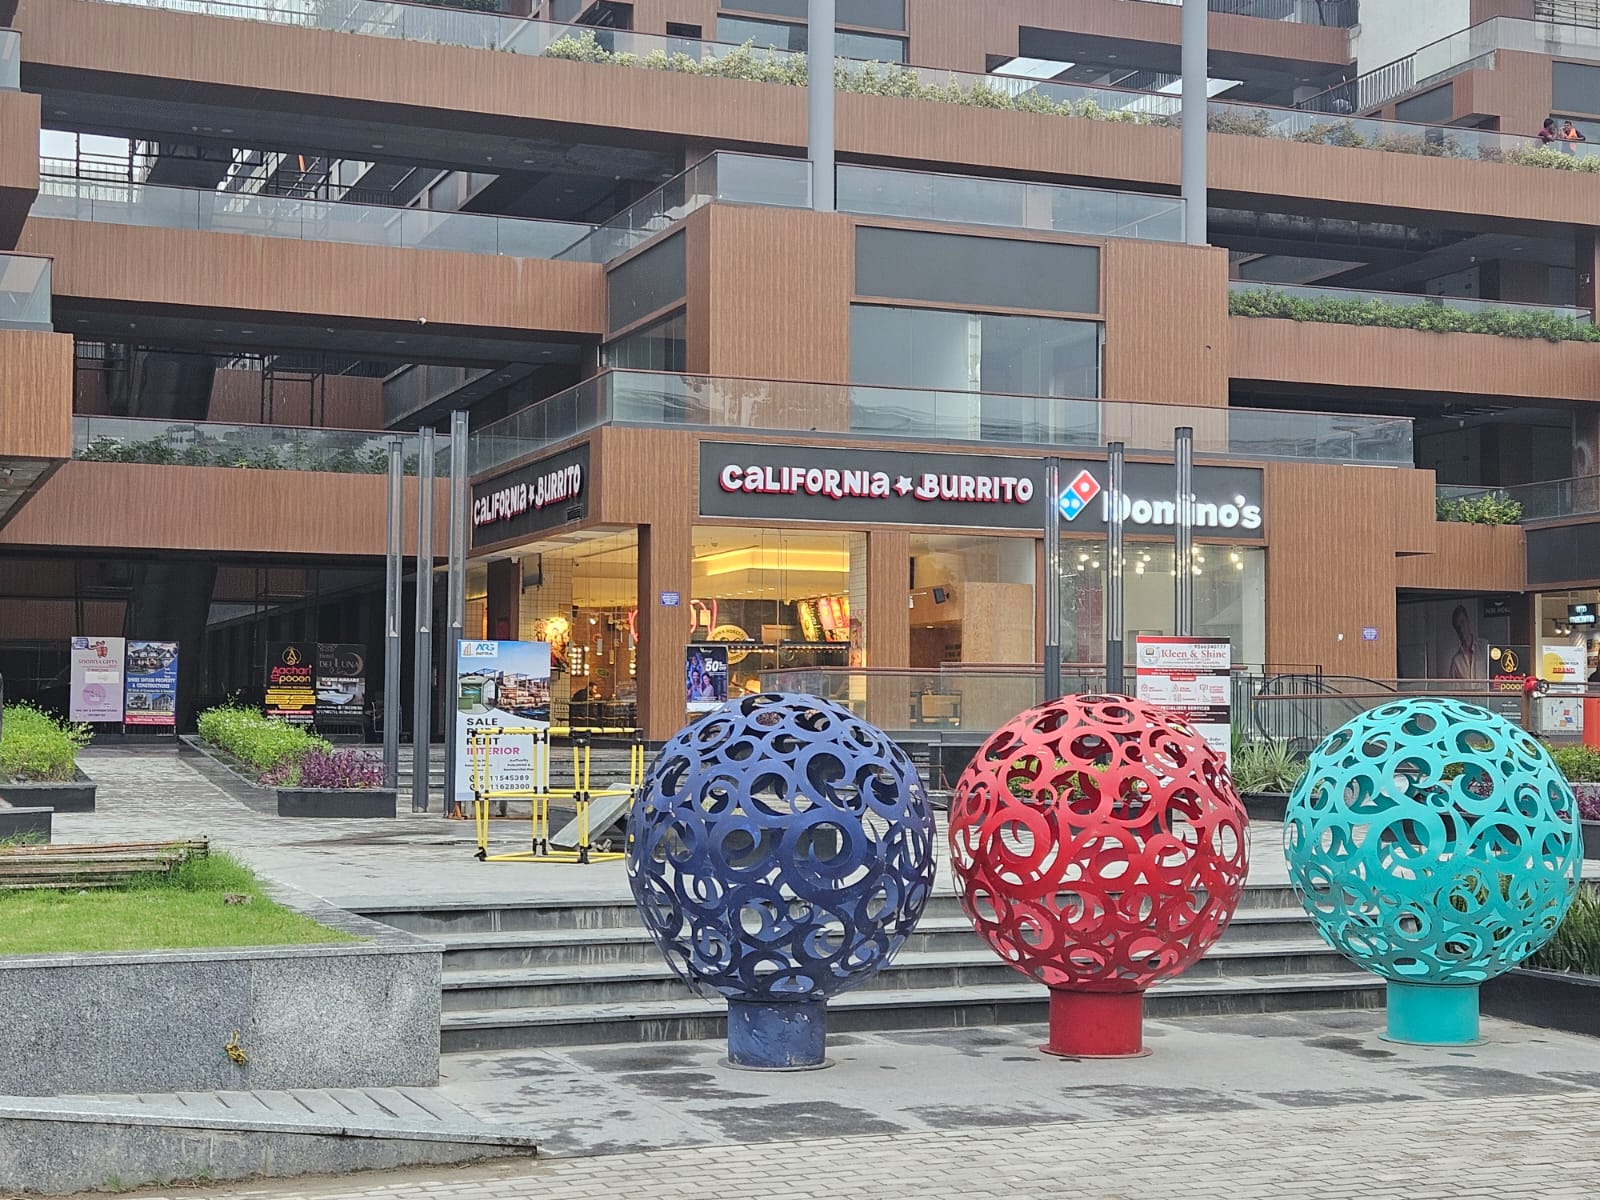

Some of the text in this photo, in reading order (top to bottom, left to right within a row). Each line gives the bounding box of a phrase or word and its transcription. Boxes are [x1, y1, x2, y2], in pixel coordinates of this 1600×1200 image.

[915, 473, 1033, 503] BURRITO
[1161, 649, 1226, 659] Kleen & Shine
[271, 665, 312, 675] Aachari
